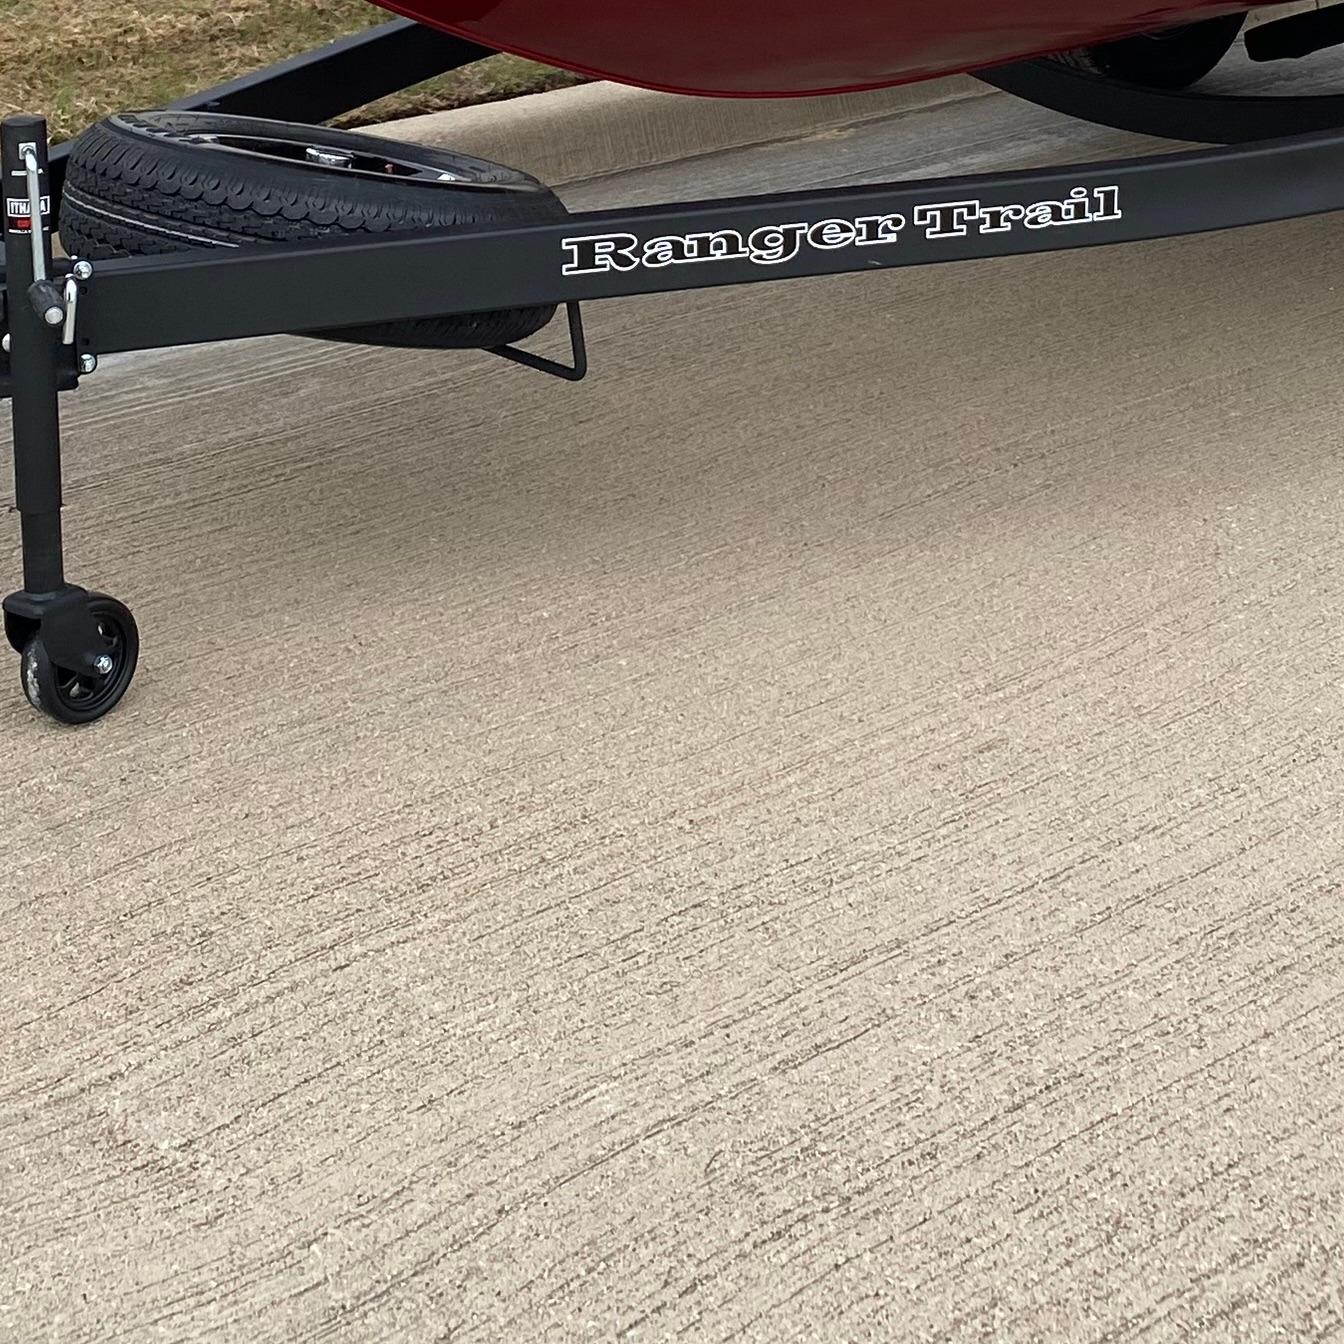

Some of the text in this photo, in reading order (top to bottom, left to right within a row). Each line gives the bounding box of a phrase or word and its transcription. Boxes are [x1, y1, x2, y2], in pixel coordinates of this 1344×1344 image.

[10, 199, 47, 214] ITHA
[561, 185, 1122, 274] Ranger Trail
